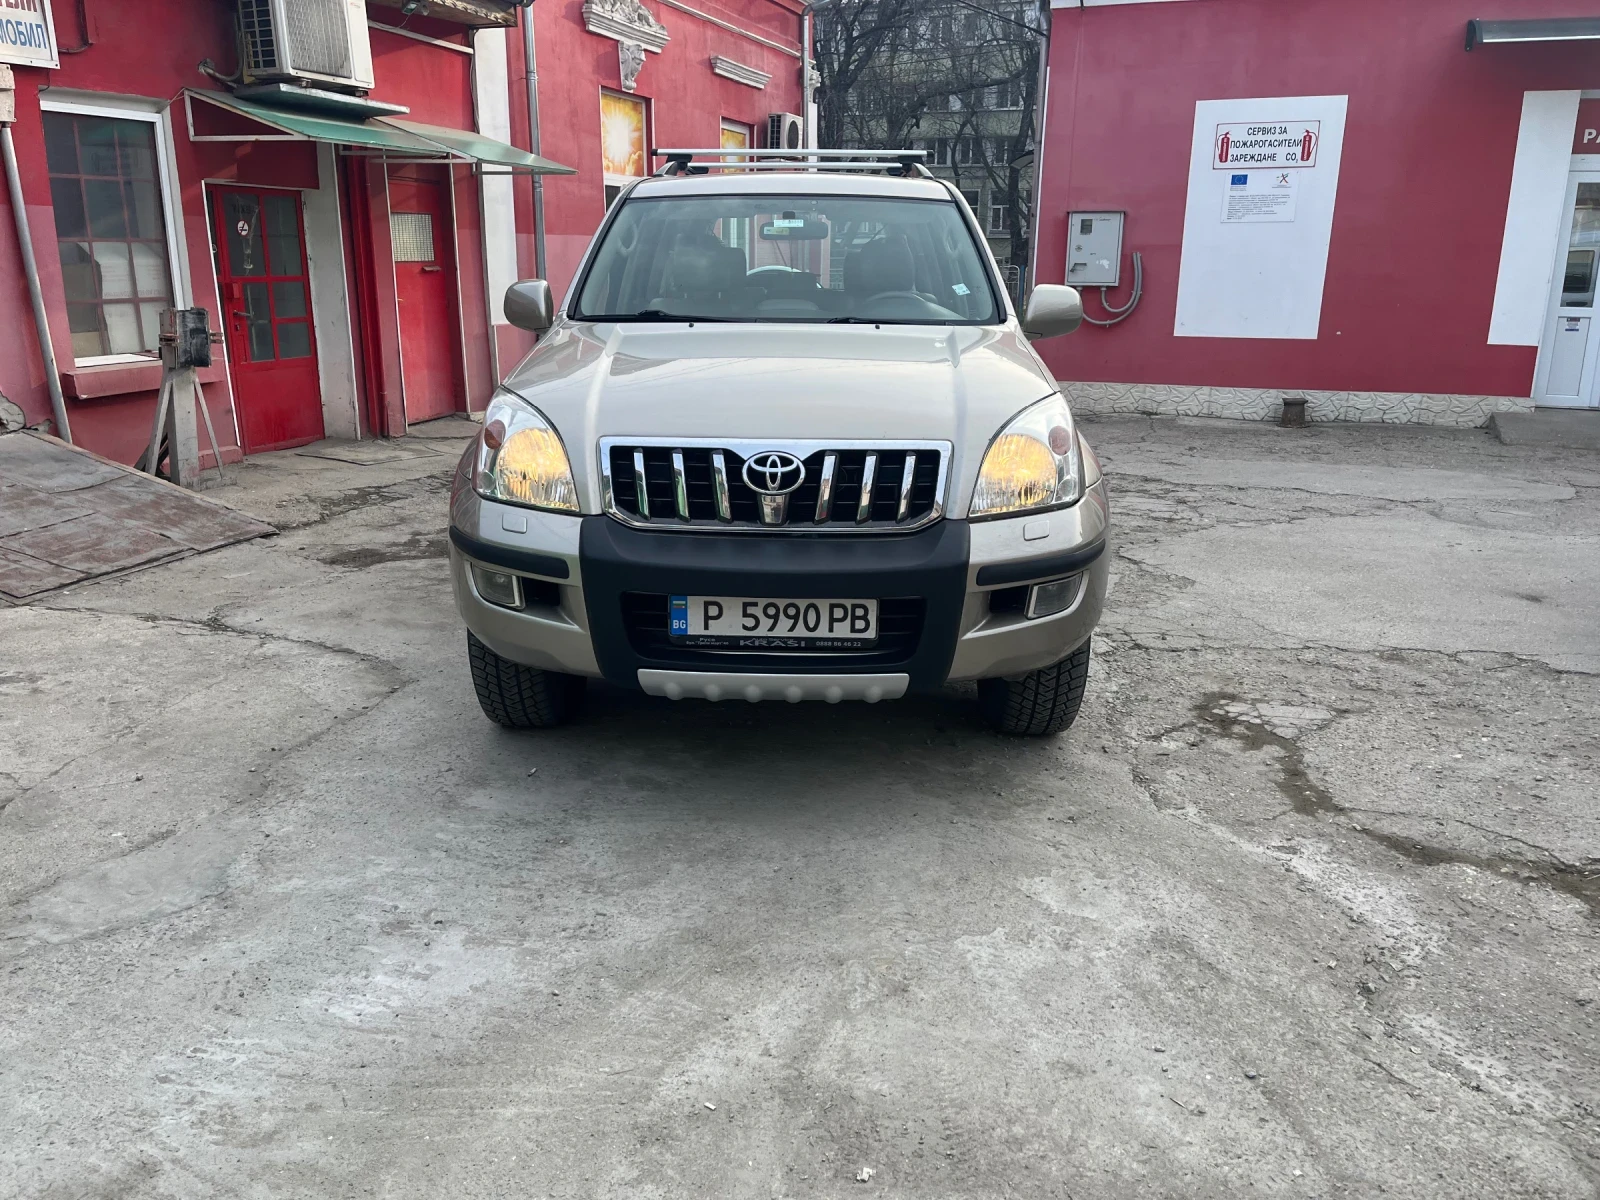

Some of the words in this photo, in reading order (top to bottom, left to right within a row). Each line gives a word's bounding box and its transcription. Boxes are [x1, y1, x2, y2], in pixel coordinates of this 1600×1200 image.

[1247, 126, 1276, 136] СЕРВИЗ
[1278, 126, 1288, 135] ЗА
[1230, 138, 1302, 149] ПОЖАРОГАСИТЕЛИ
[1230, 153, 1277, 163] ЗАРЕЖДАНЕ
[703, 600, 724, 631] P
[742, 601, 821, 633] 5990
[828, 602, 871, 634] PB
[673, 620, 687, 629] BG
